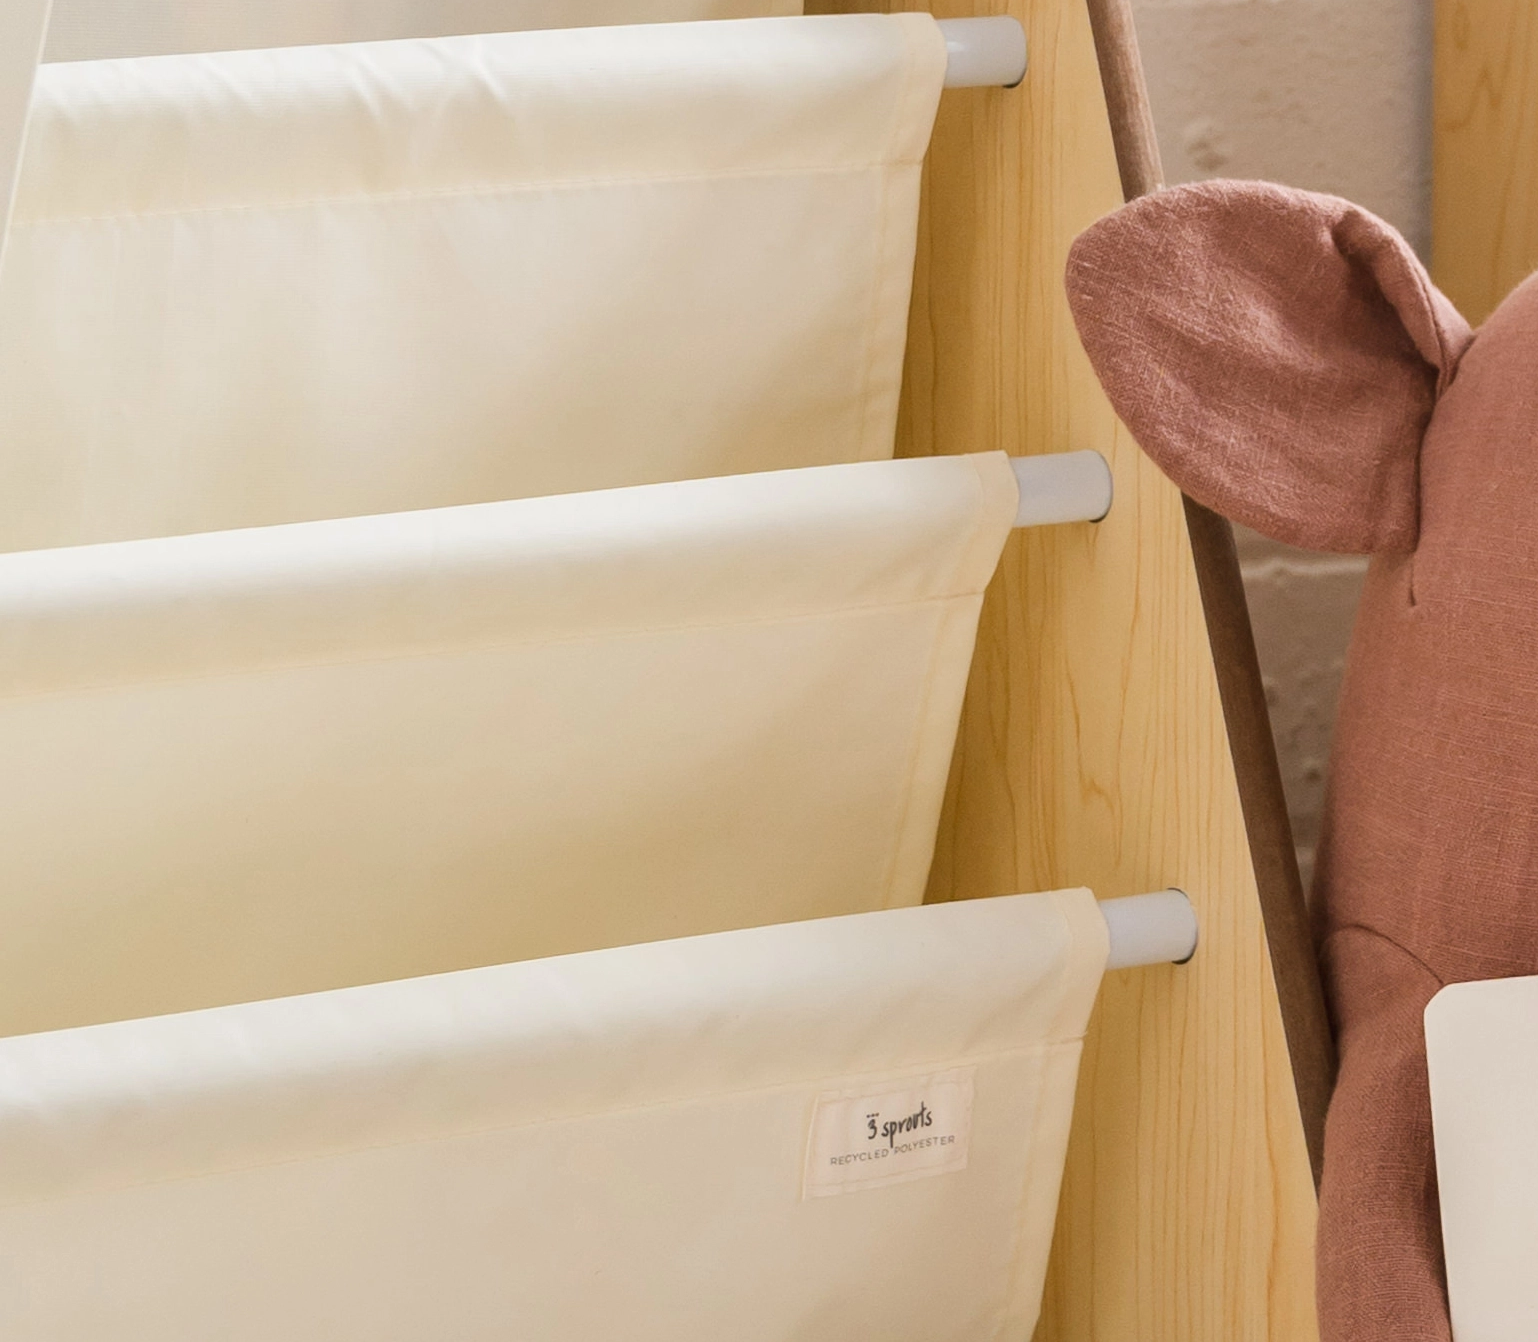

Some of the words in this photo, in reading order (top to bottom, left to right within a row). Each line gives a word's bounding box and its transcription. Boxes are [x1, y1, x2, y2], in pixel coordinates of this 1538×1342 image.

[881, 1101, 933, 1148] sprouts
[830, 1148, 889, 1166] RECYCLED
[893, 1134, 956, 1155] POLYESTER
